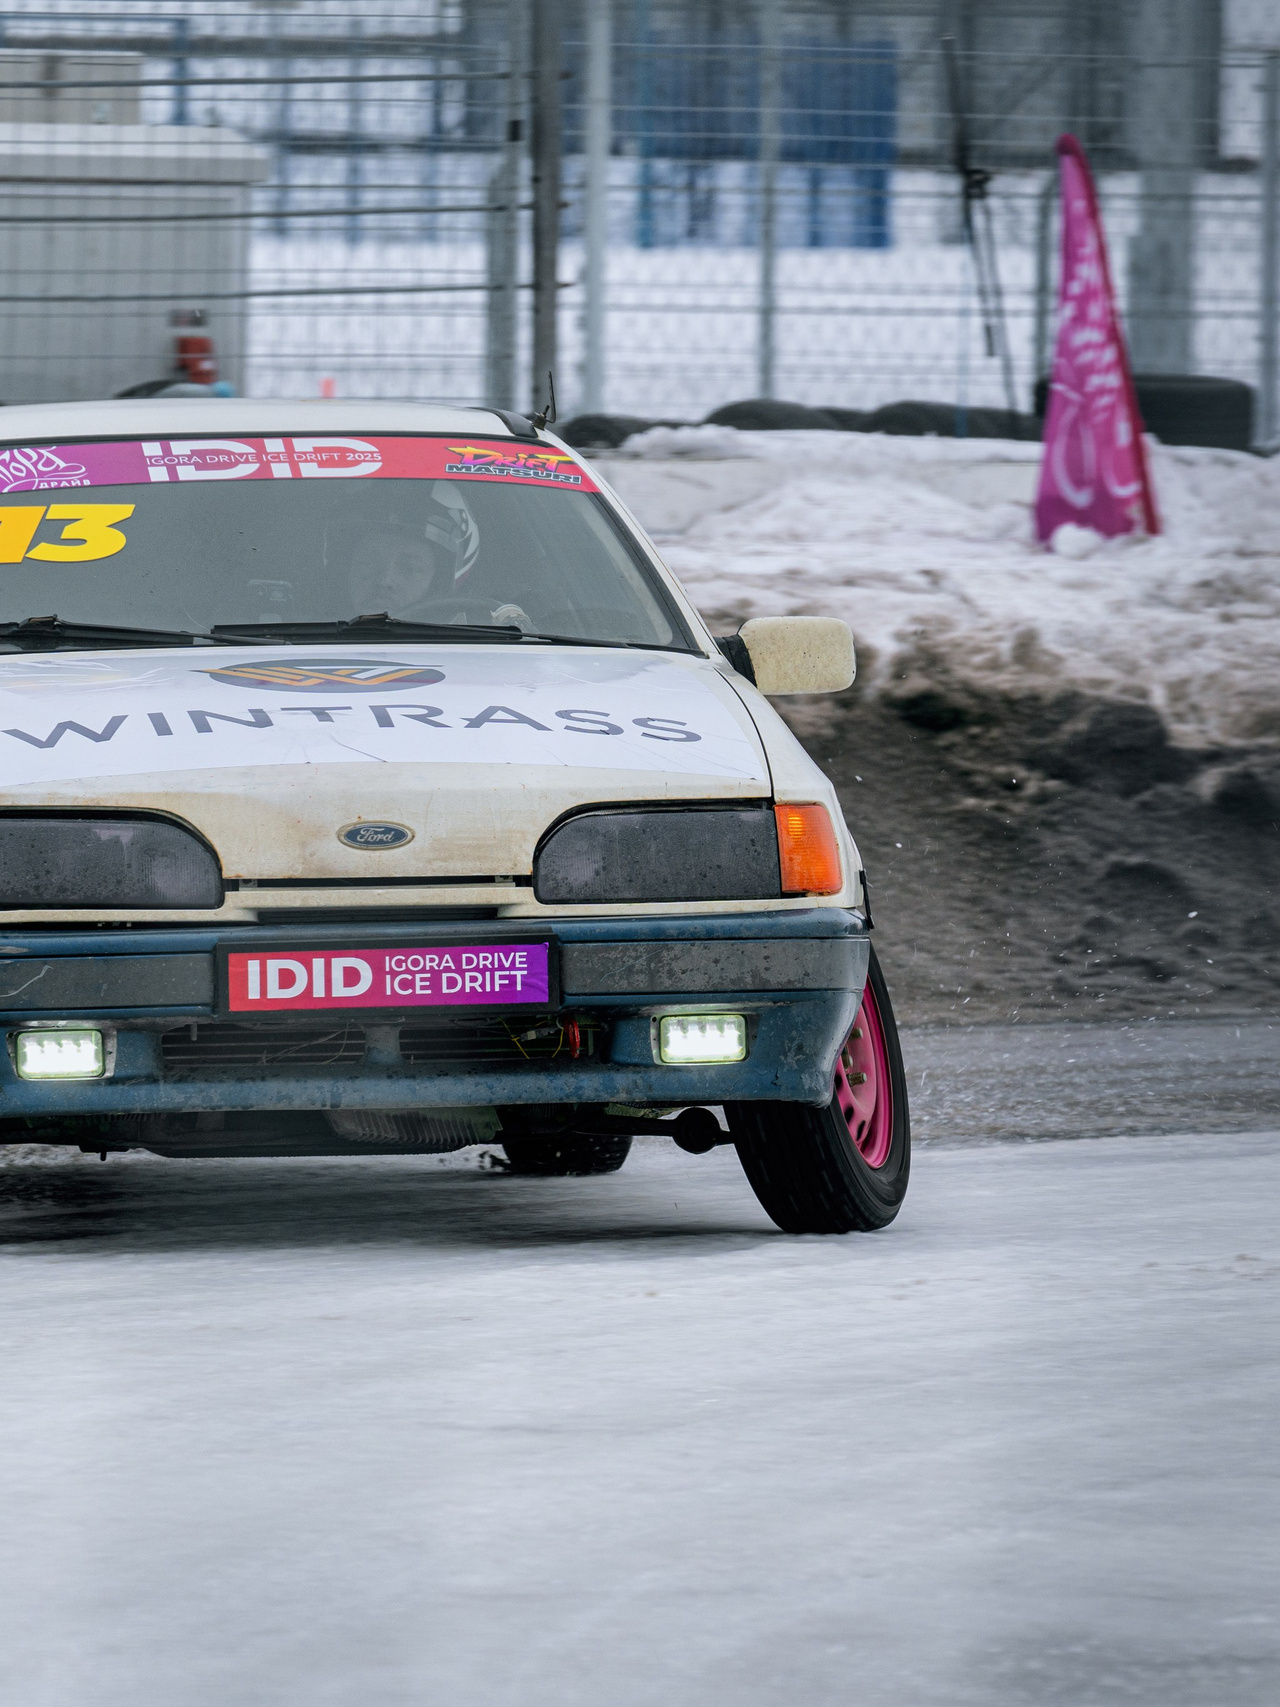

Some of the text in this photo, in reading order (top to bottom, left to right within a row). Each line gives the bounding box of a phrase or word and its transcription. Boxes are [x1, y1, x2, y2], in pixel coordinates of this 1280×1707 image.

[141, 438, 382, 482] IDID
[145, 452, 383, 465] IGORA DRIVE ICE DRIFT 2025
[38, 479, 91, 489] ДРАЙВ
[445, 463, 582, 485] MATSURI
[1, 704, 702, 749] WINTRASS
[356, 827, 395, 842] Ford
[385, 952, 528, 972] IGORA DRIVE
[247, 957, 373, 1000] IDID
[385, 970, 528, 996] ICE DRIFT
